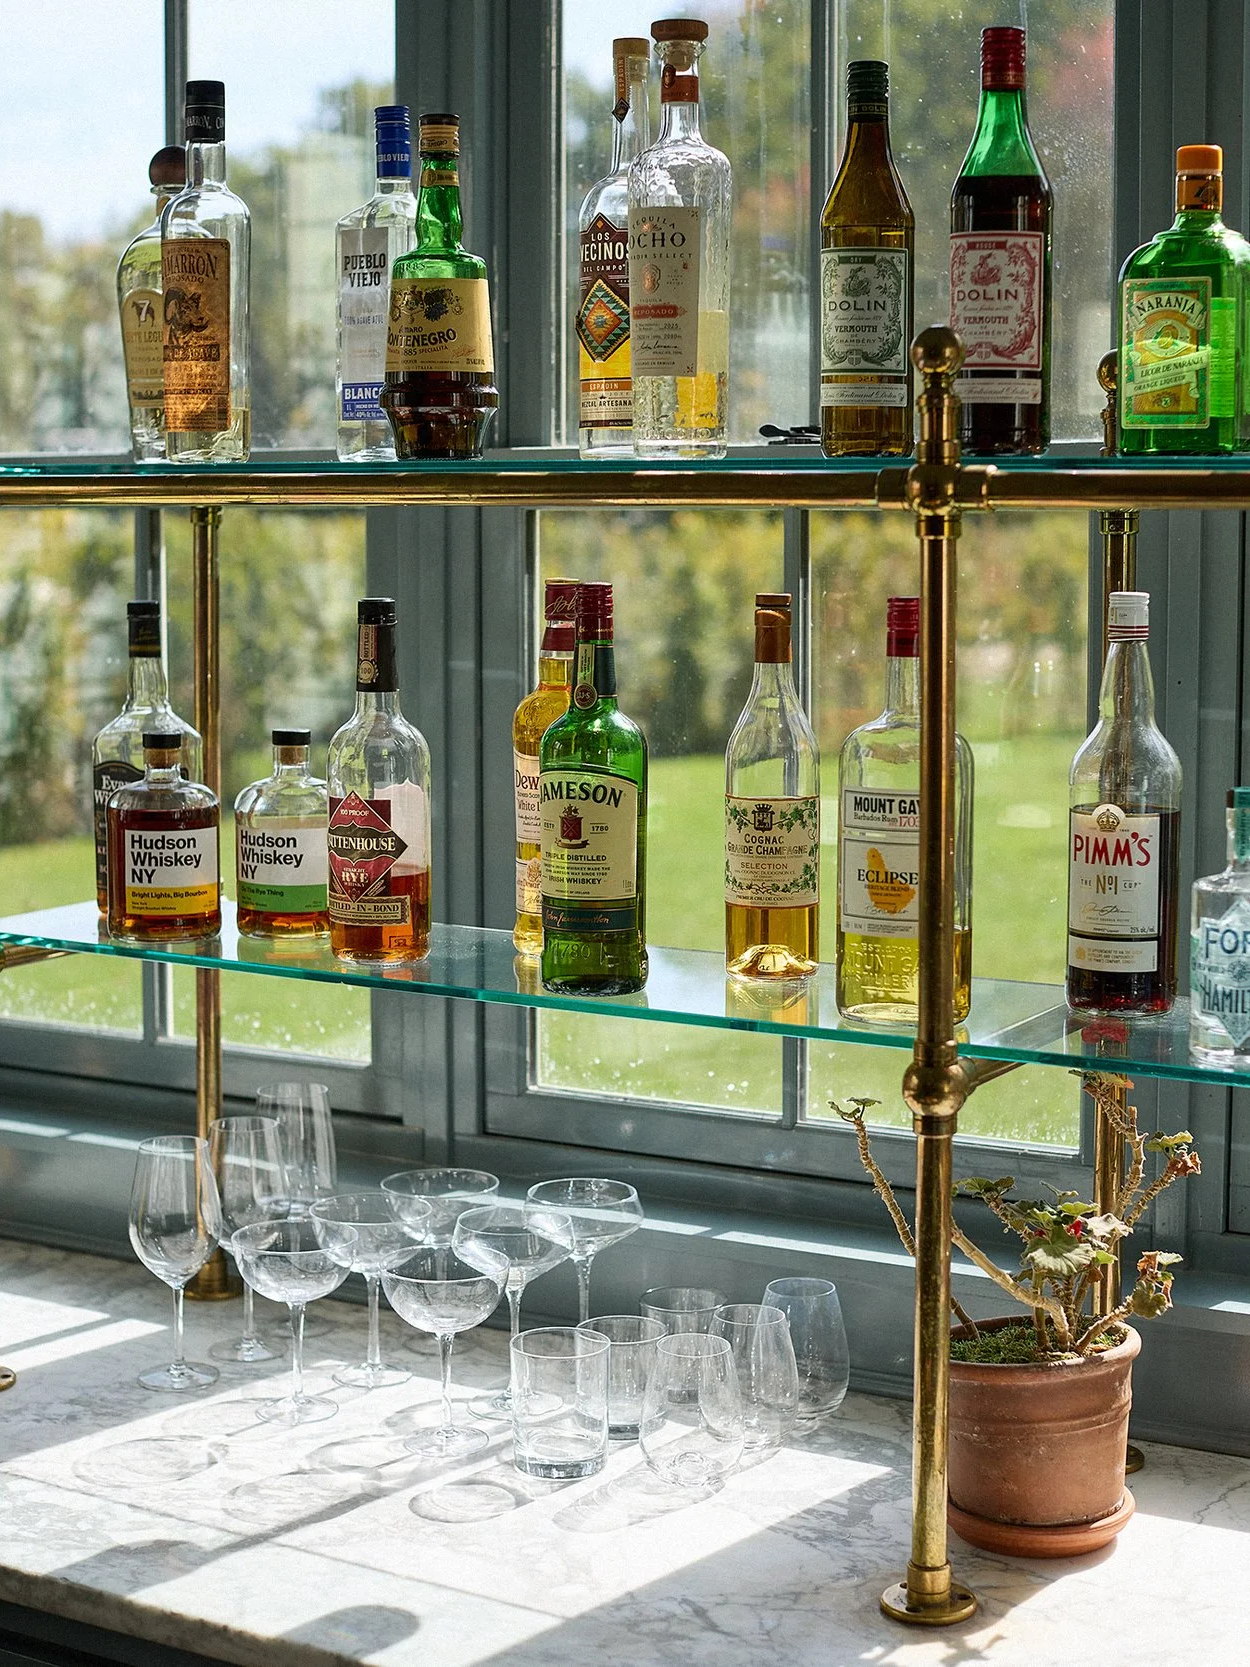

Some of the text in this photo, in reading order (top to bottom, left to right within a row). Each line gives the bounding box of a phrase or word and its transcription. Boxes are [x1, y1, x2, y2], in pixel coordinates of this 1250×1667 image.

[632, 215, 676, 230] TEQUILA
[591, 232, 610, 242] LOS
[629, 232, 686, 250] OCHO
[344, 253, 386, 271] PUEBLO
[596, 264, 622, 272] CAMPO
[349, 271, 381, 288] VIEJO
[956, 289, 1018, 301] DOLIN
[828, 300, 886, 311] DOLIN
[1136, 296, 1196, 316] NARANJA
[963, 315, 1009, 325] VERMOUTH
[834, 324, 878, 333] VERMOUTH
[144, 331, 164, 343] LEGU
[1140, 367, 1161, 378] LICOR
[1162, 364, 1173, 374] DE
[101, 774, 128, 790] Eva
[515, 769, 540, 791] Dew
[539, 780, 624, 809] JAMESON
[853, 796, 896, 815] MOUNT
[349, 808, 370, 817] PROOF
[853, 812, 881, 823] Barbados
[131, 834, 197, 850] Hudson
[241, 830, 298, 848] Hudson
[744, 833, 785, 845] COGNAC
[755, 844, 808, 856] CHAMPAGNE
[1073, 831, 1151, 867] PIMM'S
[132, 851, 202, 868] Whiskey
[241, 846, 304, 869] Whiskey
[545, 851, 565, 861] TRIPLE
[241, 863, 258, 880] NY
[740, 861, 788, 870] SELECTION
[132, 868, 157, 884] NY
[341, 871, 369, 884] RYE
[566, 877, 602, 885] WHISKEY
[857, 869, 919, 886] ECLIPSE
[1080, 878, 1092, 887] THE
[132, 889, 208, 899] Bright Lights, Big Bourbon
[266, 888, 285, 896] Thing
[356, 903, 366, 912] IN
[373, 904, 400, 912] BOND
